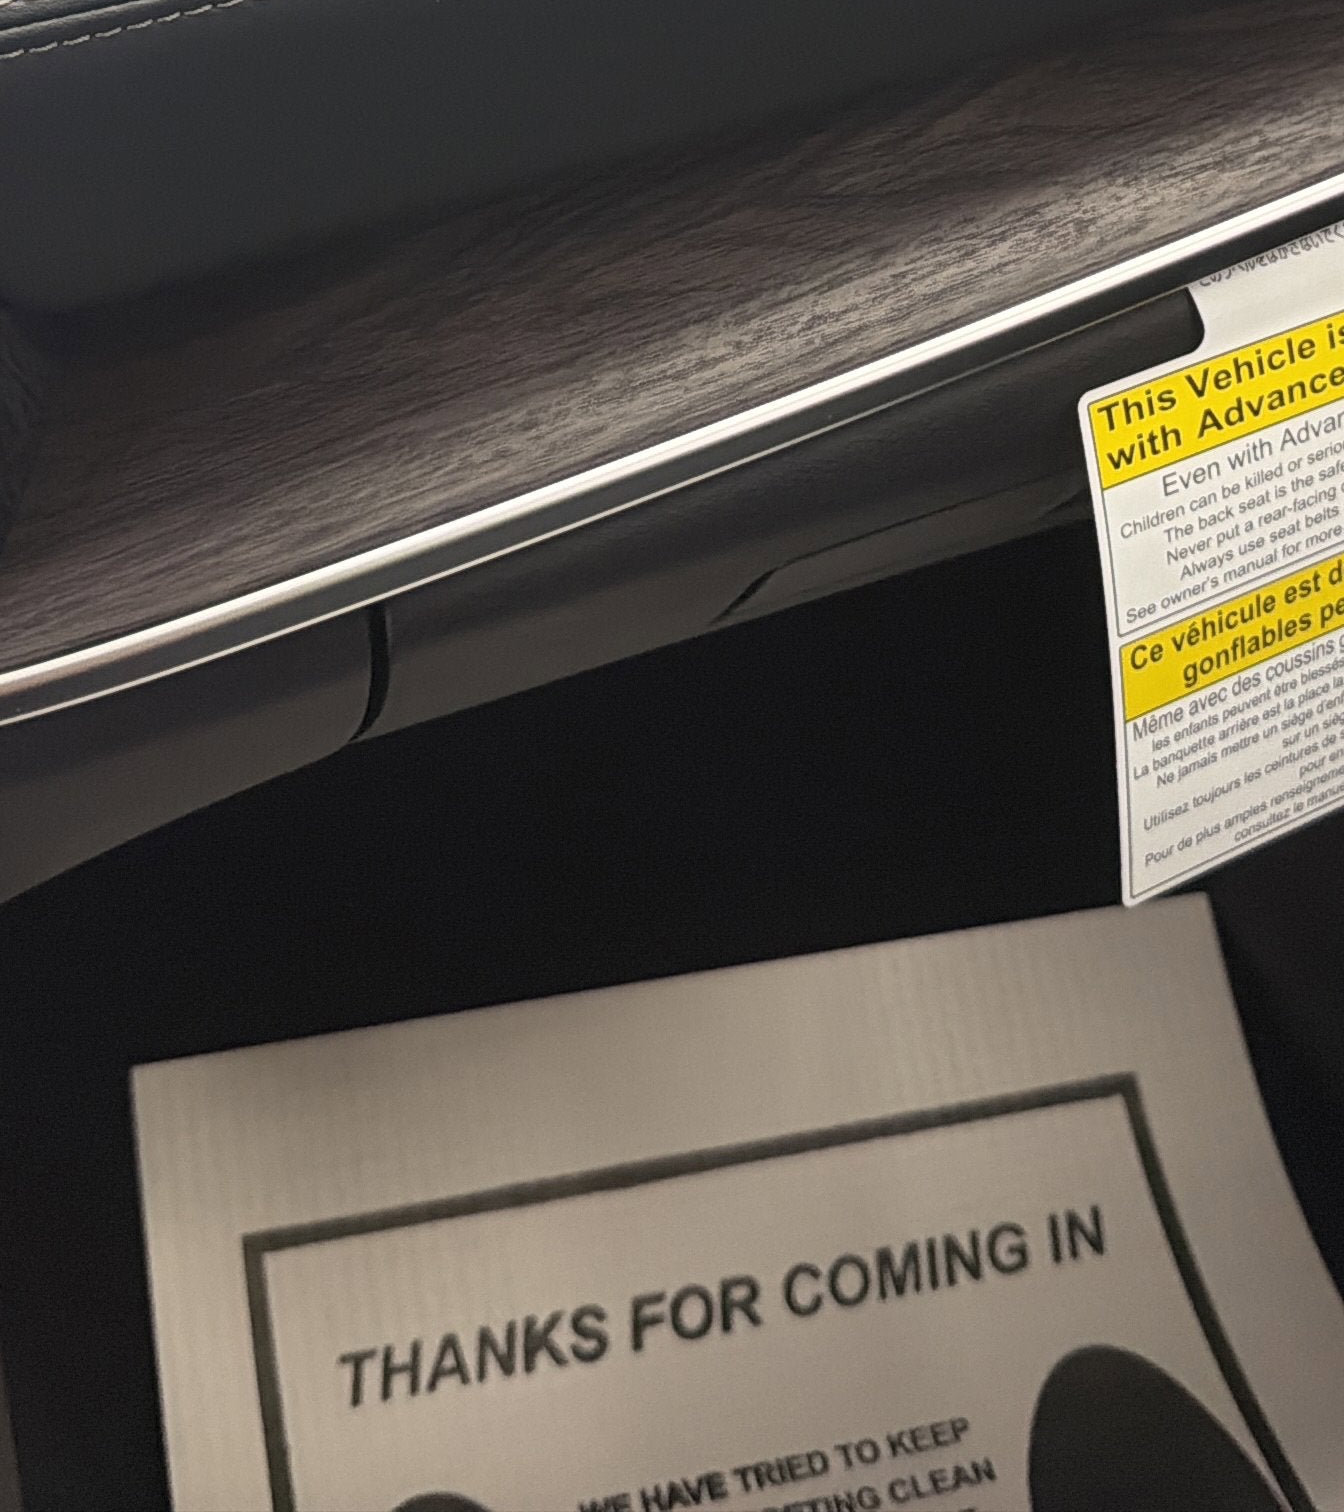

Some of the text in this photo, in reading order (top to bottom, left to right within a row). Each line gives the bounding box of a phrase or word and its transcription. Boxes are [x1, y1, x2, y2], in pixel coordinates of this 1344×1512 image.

[1096, 388, 1177, 431] This
[1183, 336, 1316, 398] Vehicle
[1105, 424, 1182, 470] with
[1161, 460, 1221, 497] Even
[1226, 437, 1273, 471] with
[1119, 504, 1186, 539] Children
[1188, 491, 1217, 513] can
[1220, 482, 1241, 500] be
[1244, 461, 1284, 490] killed
[1286, 456, 1303, 473] or
[1162, 522, 1194, 543] The
[1197, 504, 1235, 531] back
[1237, 489, 1271, 514] seat
[1273, 484, 1287, 499] is
[1289, 474, 1315, 493] the
[1165, 535, 1213, 566] Never
[1215, 522, 1241, 548] put
[1243, 519, 1254, 533] a
[1257, 485, 1337, 528] rear-facing
[1125, 602, 1157, 624] See
[1159, 575, 1219, 610] owner's
[1222, 547, 1278, 583] manual
[1280, 540, 1302, 557] for
[1304, 524, 1342, 548] more
[1179, 548, 1234, 581] Always
[1237, 535, 1265, 556] use
[1268, 518, 1301, 543] seat
[1304, 505, 1340, 528] belts
[1129, 642, 1164, 670] Ce
[1170, 592, 1276, 652] véhicule
[1283, 569, 1321, 605] est
[1182, 612, 1312, 689] gonflables
[1131, 706, 1184, 742] Même
[1188, 686, 1227, 717] avec
[1231, 671, 1261, 697] des
[1265, 639, 1335, 682] coussins
[339, 1204, 1106, 1408] THANKS FOR COMING IN
[640, 1471, 729, 1512] HAVE
[732, 1449, 831, 1493] TRIED
[833, 1438, 882, 1470] TO
[886, 1416, 970, 1458] KEEP
[888, 1456, 998, 1505] CLEAN
